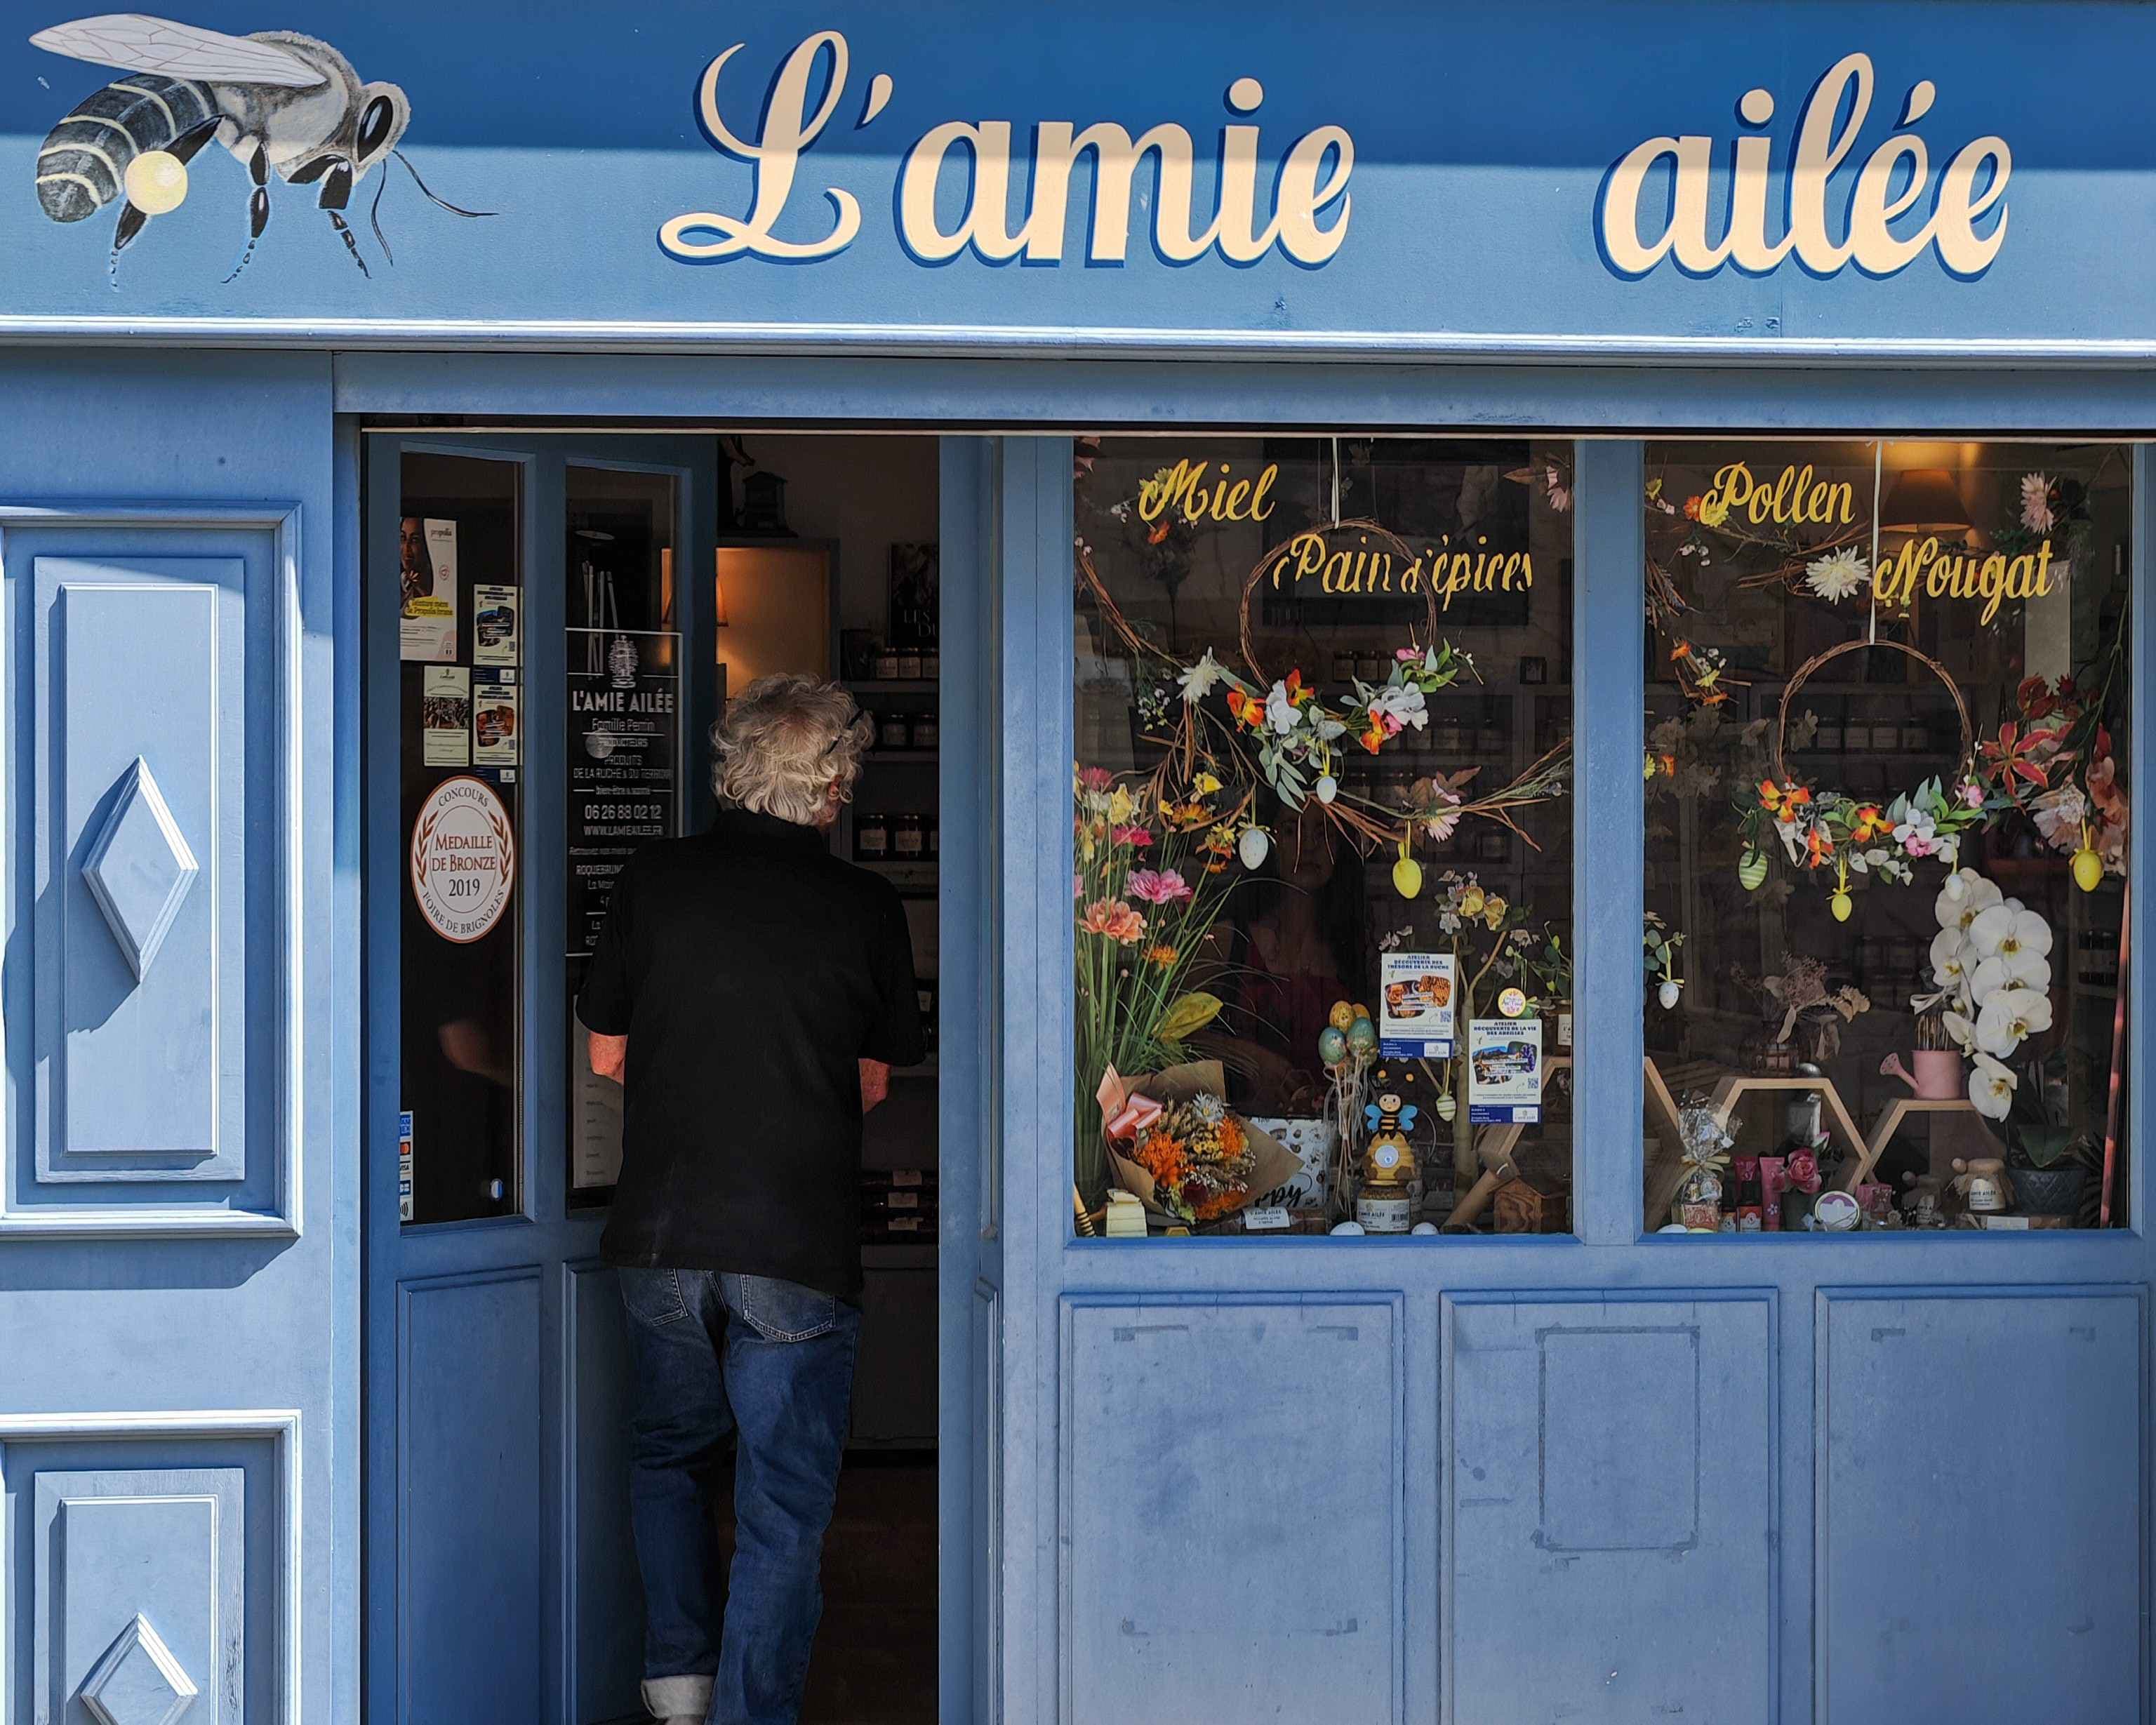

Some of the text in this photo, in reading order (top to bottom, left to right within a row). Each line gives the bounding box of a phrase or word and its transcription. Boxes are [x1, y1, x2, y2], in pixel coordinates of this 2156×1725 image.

[659, 29, 2013, 279] L'amie ailée
[1137, 458, 1278, 522] Miel
[1699, 460, 1855, 526] Pollen
[1273, 533, 1392, 594] Pain
[1872, 536, 2056, 626] Nougat
[572, 688, 674, 713] L'AMIE AILÉE
[438, 787, 490, 808] CONCOURS
[585, 805, 600, 820] 06
[601, 805, 615, 820] 26
[633, 805, 648, 820] 02
[649, 805, 663, 820] 12
[434, 833, 493, 851] MEDAILLE
[432, 854, 495, 872] DE BRONZE
[448, 879, 481, 897] 2019
[422, 890, 505, 934] FOIRE DE BRIGNOLES
